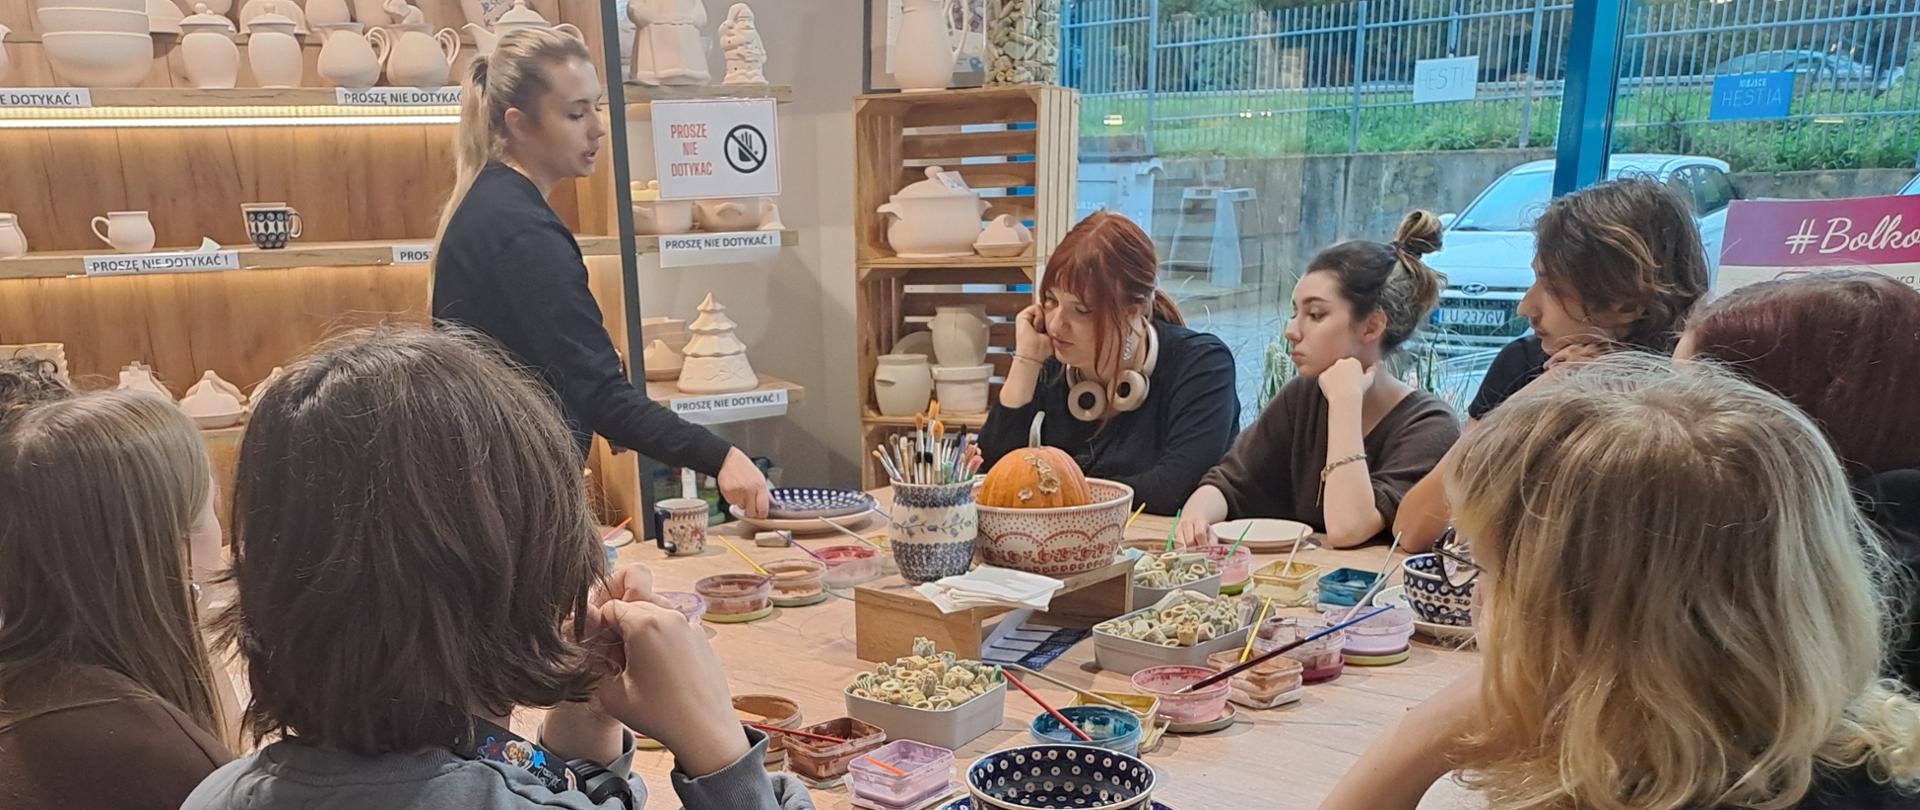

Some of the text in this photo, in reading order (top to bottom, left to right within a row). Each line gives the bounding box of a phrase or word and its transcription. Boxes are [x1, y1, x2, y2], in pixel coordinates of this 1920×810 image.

[10, 92, 72, 105] DOTYKAĆ
[344, 92, 387, 105] PROSZĘ
[390, 93, 409, 103] NIE
[1721, 88, 1782, 107] HESTIA
[683, 142, 699, 156] NIE
[664, 240, 702, 250] PROSZĘ
[704, 238, 720, 247] NIE
[722, 234, 767, 247] DOTYKAĆ
[92, 259, 139, 272] PROSZĘ
[142, 258, 161, 269] NIE
[165, 254, 222, 268] DOTYKAĆ
[400, 251, 432, 261] PROS
[1441, 309, 1503, 324] LU 237GV
[676, 400, 712, 411] PROSZĘ
[714, 398, 729, 408] NIE
[731, 393, 774, 407] DOTYKAĆ
